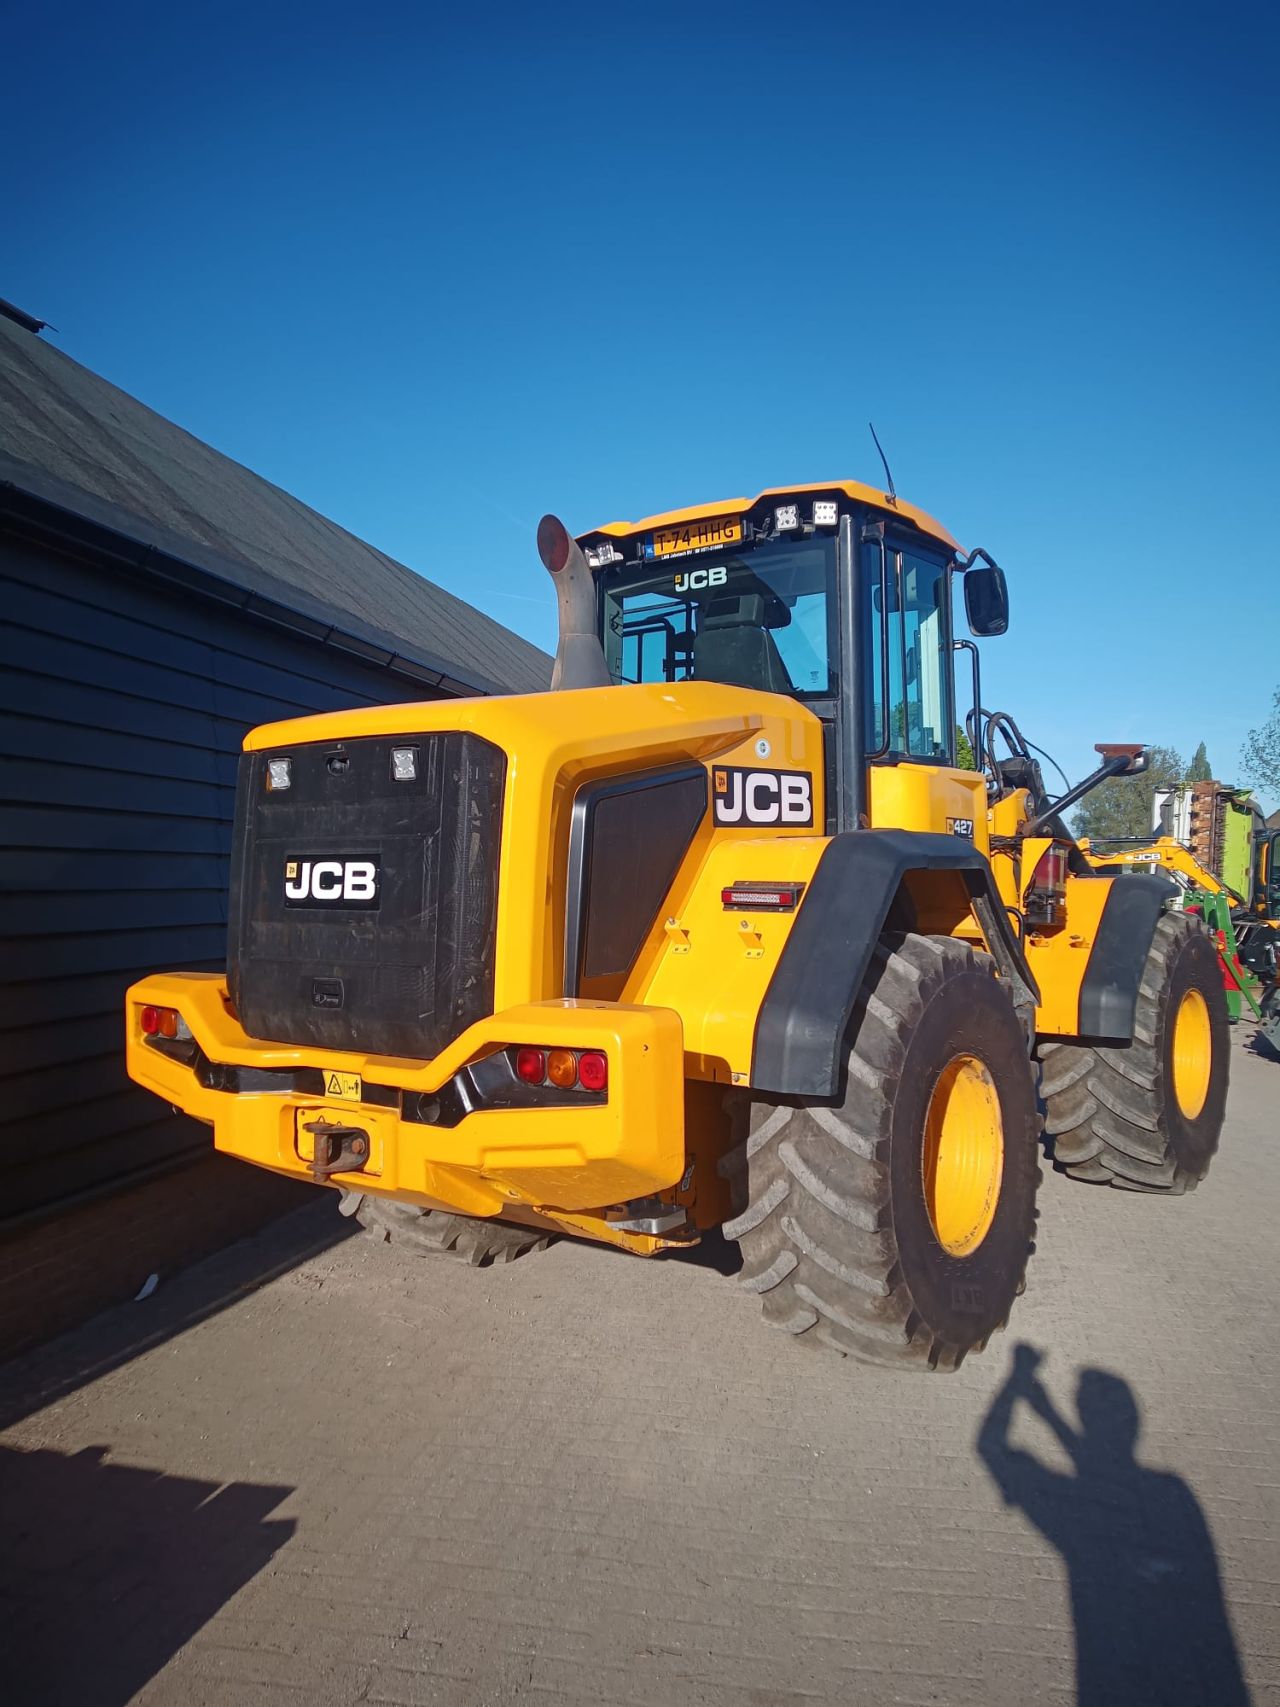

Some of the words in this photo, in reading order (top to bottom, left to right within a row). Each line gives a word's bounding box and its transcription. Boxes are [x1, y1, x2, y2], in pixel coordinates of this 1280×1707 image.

[657, 520, 734, 552] T-74-HHG
[675, 567, 728, 592] JCB
[716, 772, 812, 823] JCB
[954, 819, 973, 834] 427
[1134, 853, 1161, 861] JCB
[285, 862, 376, 900] JCB
